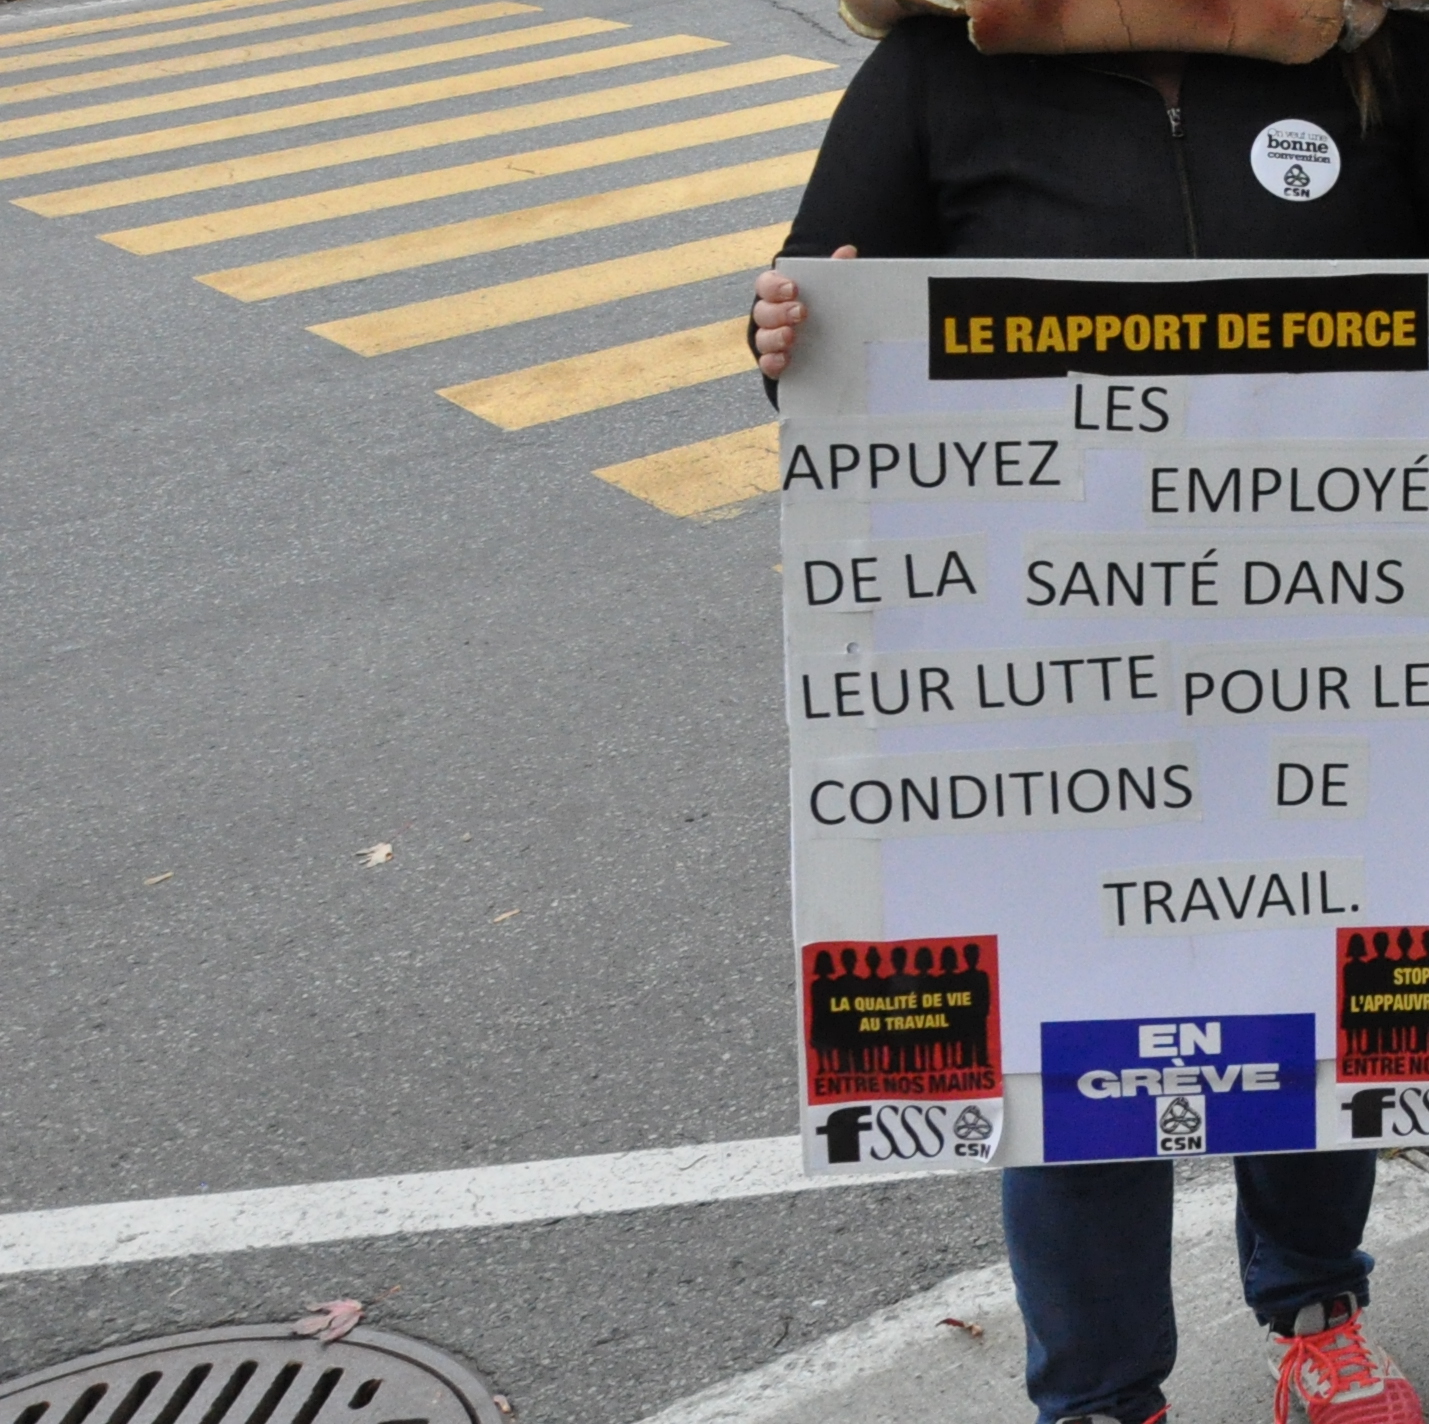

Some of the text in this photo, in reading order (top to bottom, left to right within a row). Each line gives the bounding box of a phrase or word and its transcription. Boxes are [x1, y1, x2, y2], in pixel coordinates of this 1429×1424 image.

[1267, 134, 1328, 154] bonne
[1267, 151, 1331, 164] convention
[1284, 188, 1310, 198] CSN
[944, 310, 1417, 354] LE RAPPORT DE FORCE
[1074, 383, 1169, 433] LES
[782, 440, 1061, 491] APPUYEZ
[804, 548, 1405, 607] DE LA SANTÉ DANS
[802, 667, 955, 719] LEUR
[977, 654, 1158, 709] LUTTE
[1185, 666, 1350, 716] POUR
[810, 762, 1349, 826] CONDITIONS DE
[1102, 870, 1359, 927] TRAVAIL.
[830, 992, 971, 1012] LA QUALITÉ DE VIE
[859, 1014, 949, 1032] AU TRAVAIL
[1139, 1022, 1221, 1058] EN
[1077, 1058, 1280, 1099] GRÈVE
[1343, 1057, 1405, 1076] ENTRE
[815, 1071, 995, 1096] ENTRE NOS MAINS
[955, 1143, 991, 1159] CSN
[1160, 1136, 1202, 1151] CSN
